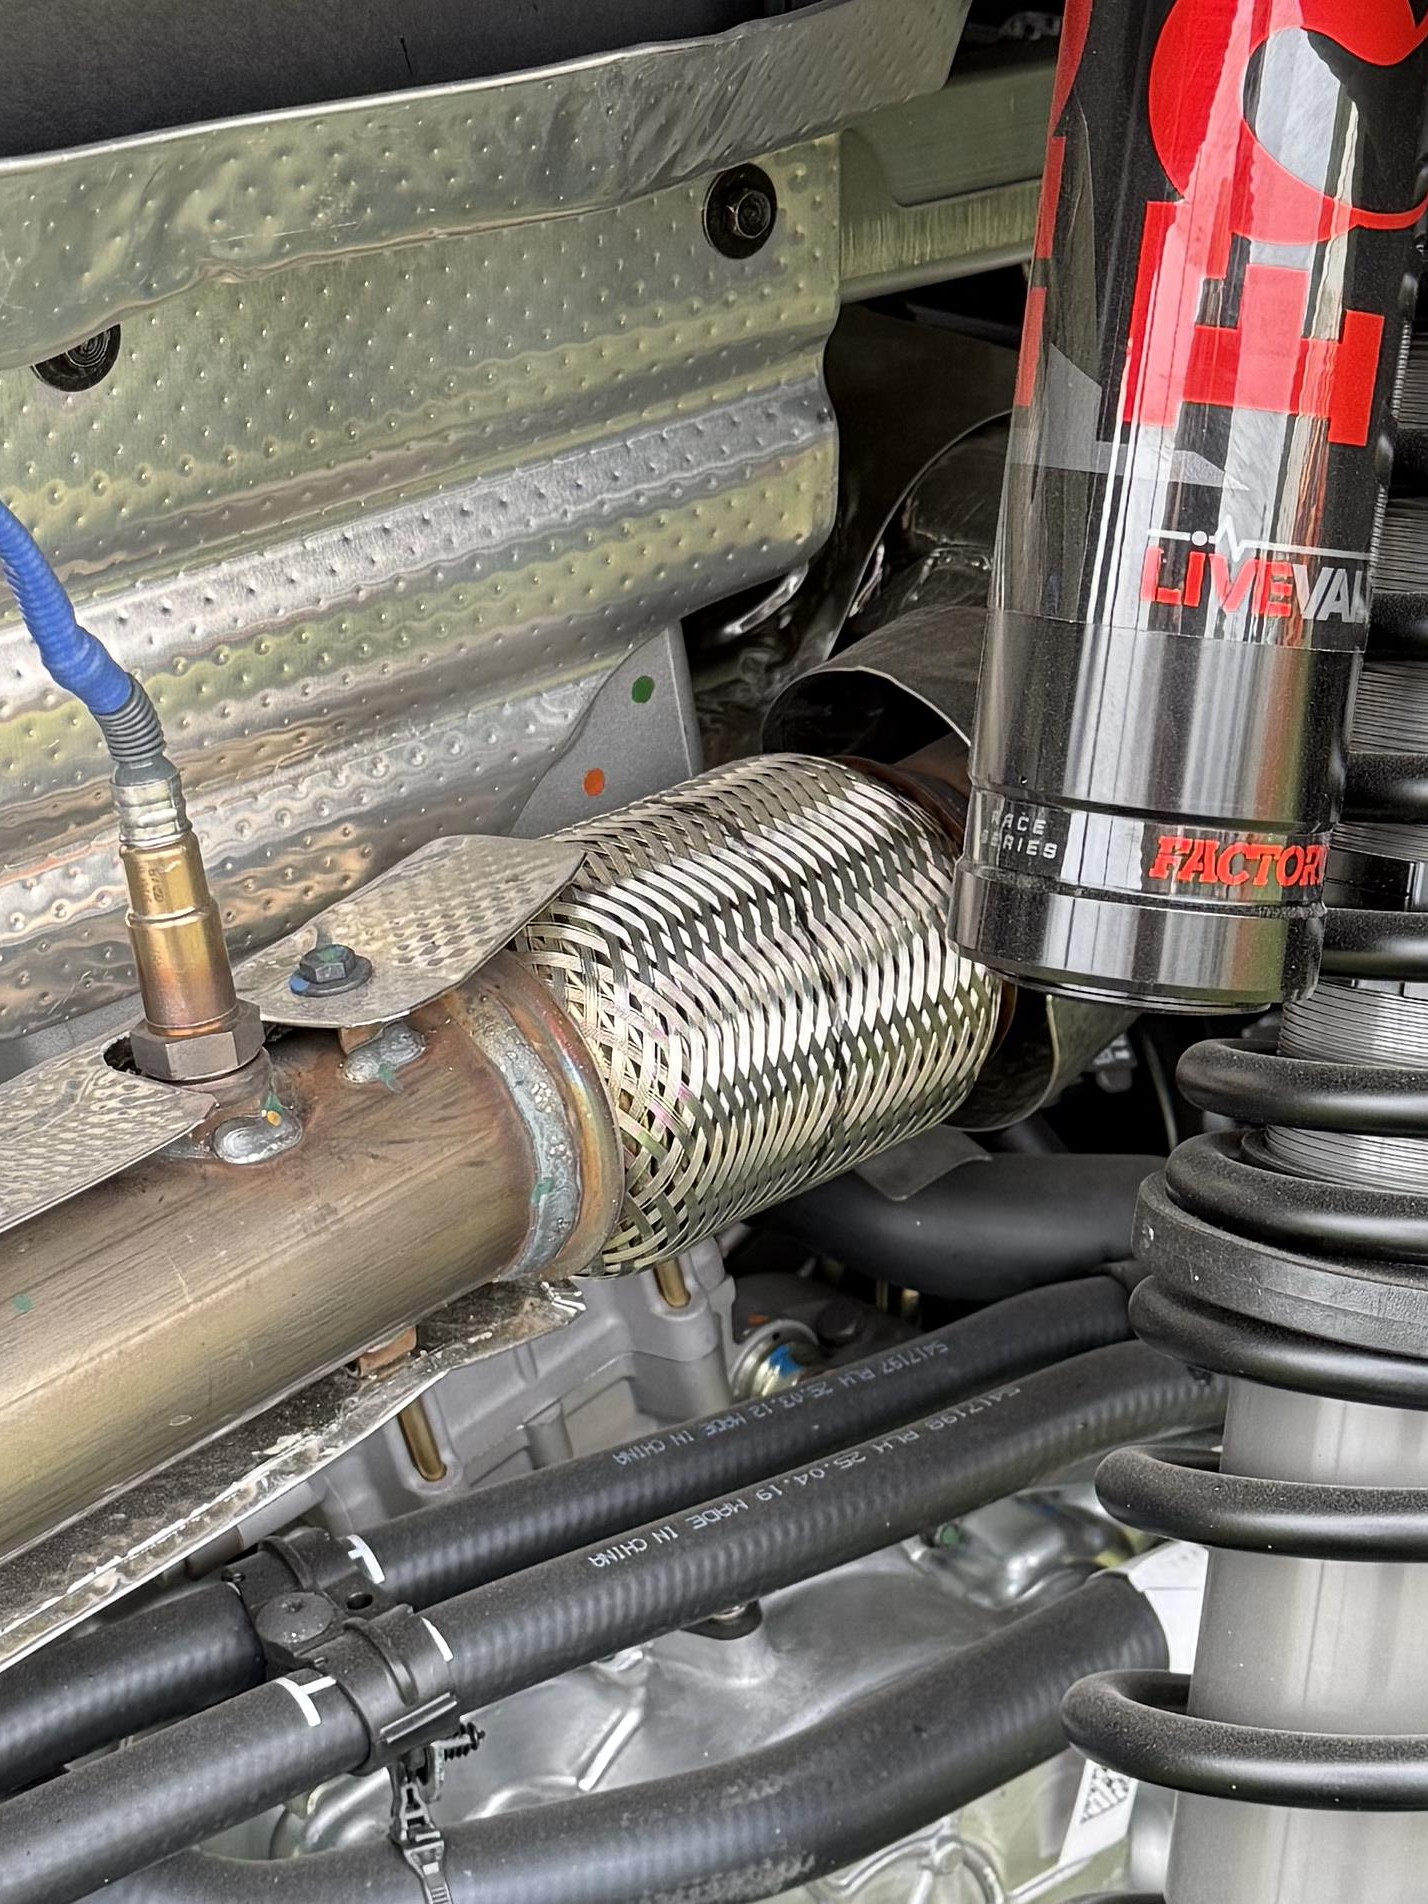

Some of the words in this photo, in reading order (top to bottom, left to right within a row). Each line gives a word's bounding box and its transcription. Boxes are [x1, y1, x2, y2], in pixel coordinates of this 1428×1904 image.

[990, 809, 1048, 836] RACE
[980, 828, 1059, 860] SERIES
[1148, 835, 1328, 888] FACTOR
[669, 1429, 696, 1447] IN
[702, 1412, 748, 1437] MADE
[612, 1438, 667, 1466] CHINA
[755, 1450, 867, 1502] 25.04.19
[684, 1498, 750, 1531] MADE
[651, 1525, 680, 1545] IN
[587, 1537, 649, 1568] CHINA
